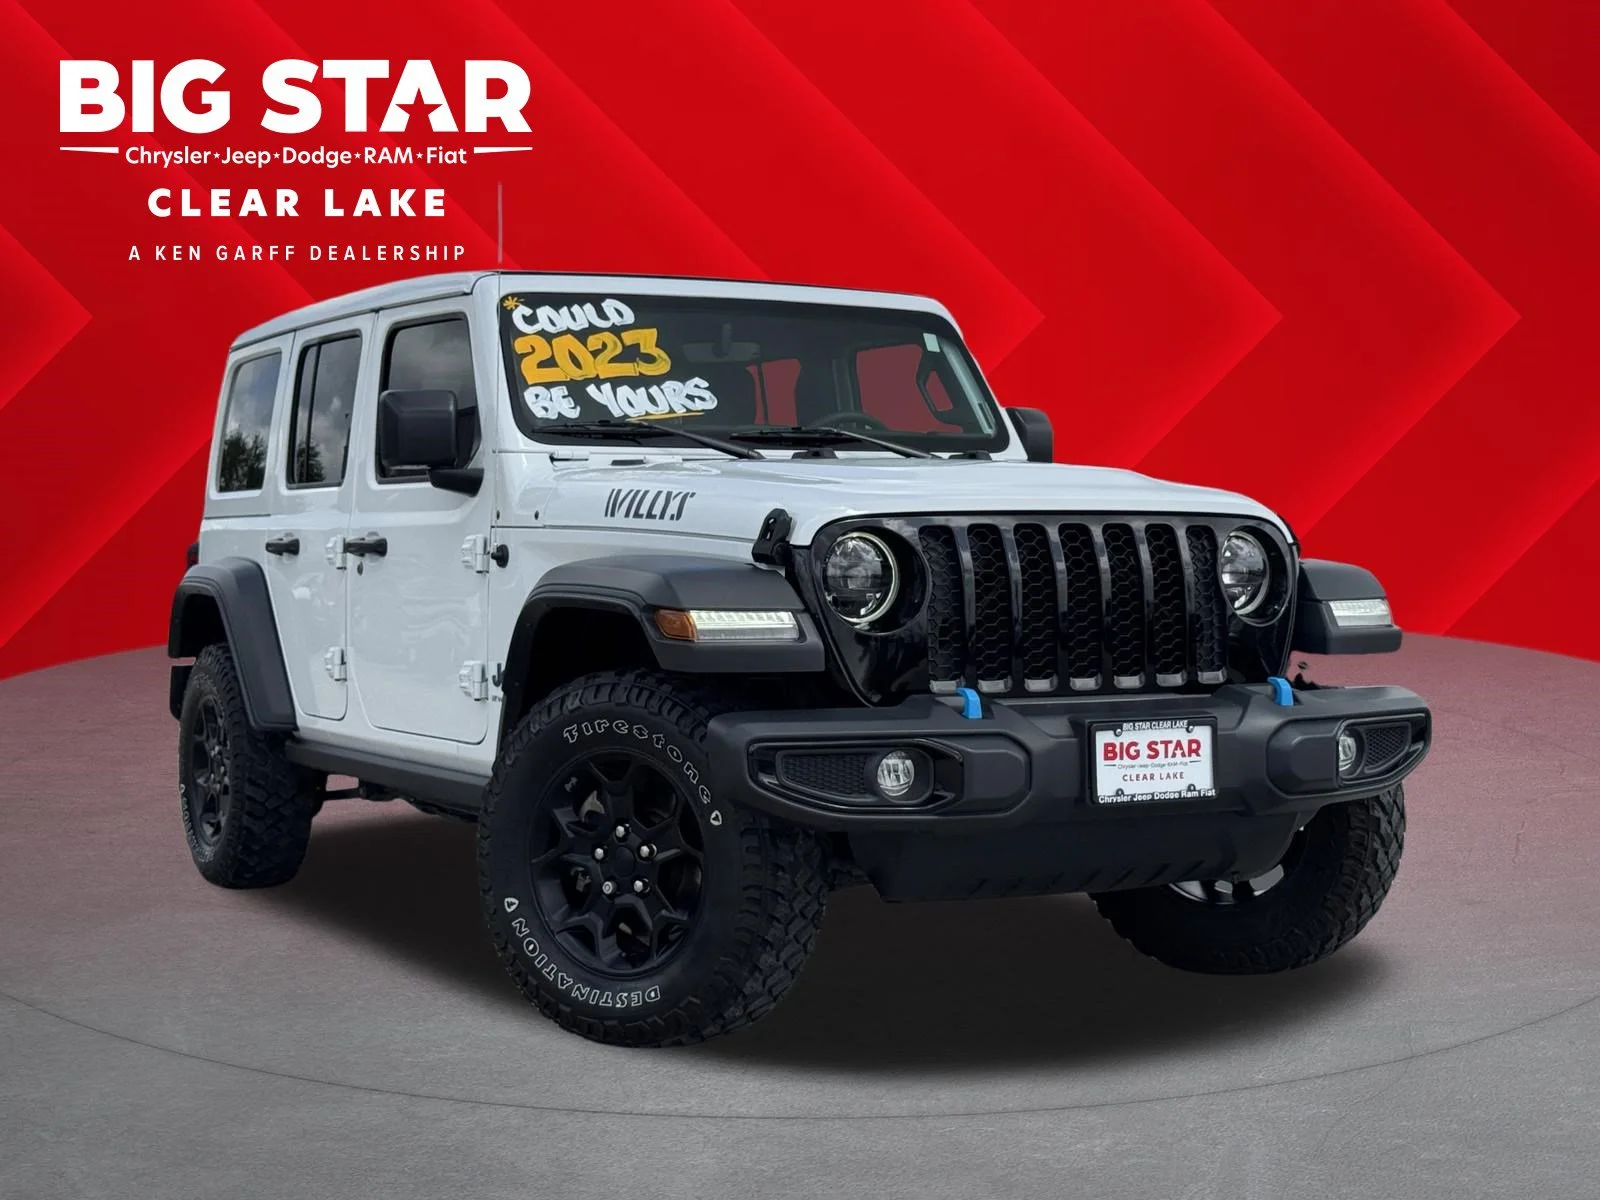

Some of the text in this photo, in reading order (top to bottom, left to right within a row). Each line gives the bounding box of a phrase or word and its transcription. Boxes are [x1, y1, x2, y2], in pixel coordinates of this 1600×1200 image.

[512, 298, 635, 334] COULD
[514, 328, 671, 385] 2023
[524, 377, 718, 419] BE YOURS
[604, 488, 697, 521] WILLYS
[1122, 719, 1189, 732] BIG STAR CLEAR LAKE
[563, 719, 711, 804] Firestone
[1103, 738, 1202, 761] BIG STAR
[1122, 771, 1185, 782] CLEAR LAKE
[1098, 788, 1216, 804] Chrysler Jeep Dodge Ram Fiat
[512, 918, 661, 1008] DESTINATION
